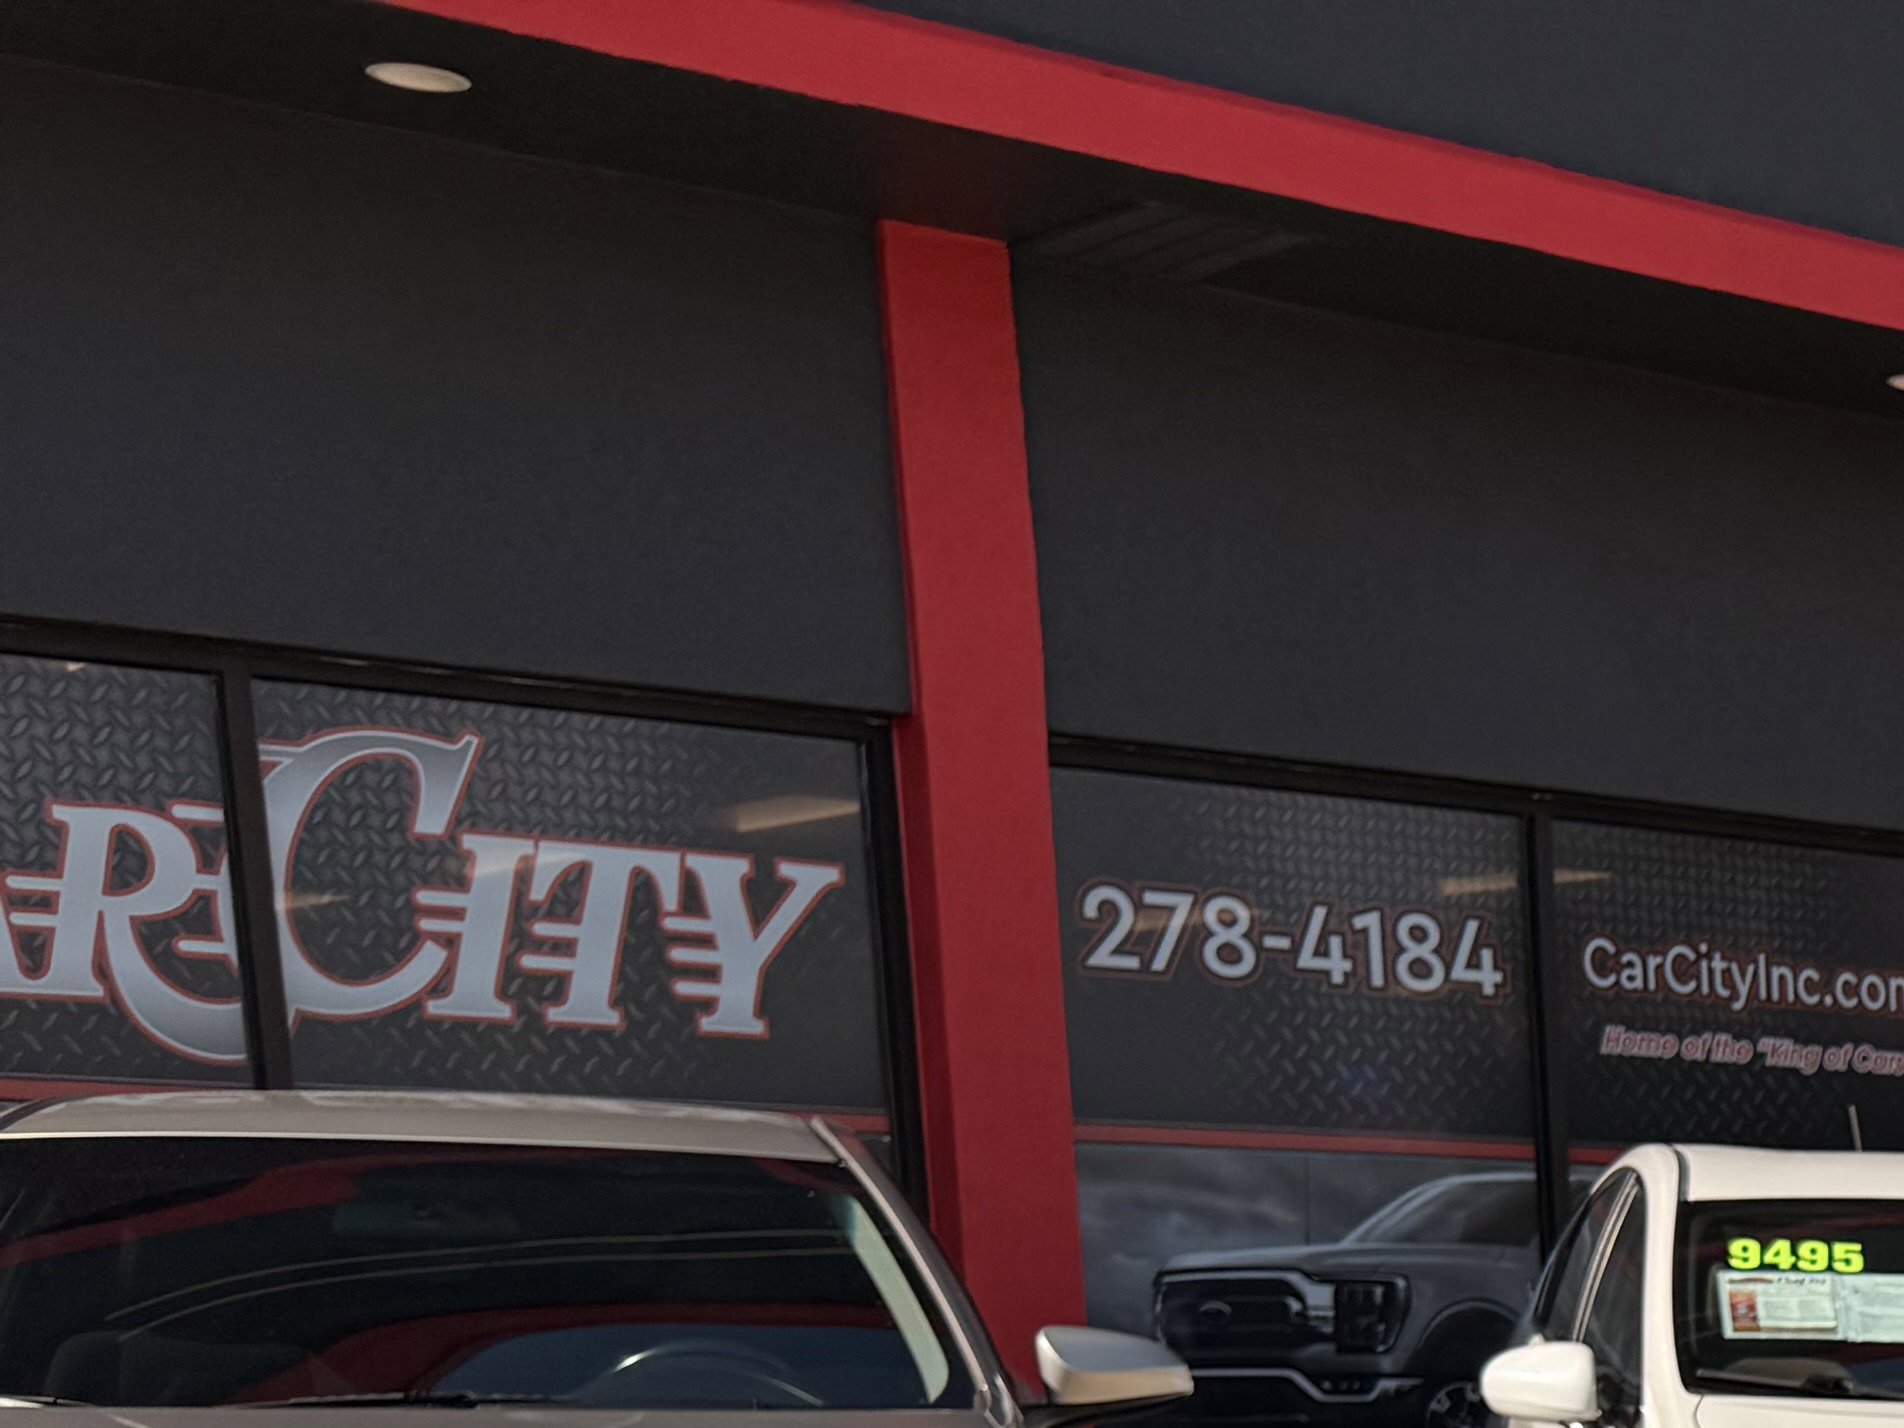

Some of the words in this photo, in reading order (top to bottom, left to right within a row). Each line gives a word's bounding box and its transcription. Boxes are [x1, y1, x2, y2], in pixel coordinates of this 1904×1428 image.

[1079, 883, 1504, 997] 278-4184
[1600, 1024, 1679, 1059] Home
[1680, 1031, 1712, 1061] of
[1709, 1032, 1754, 1065] the
[1822, 1041, 1854, 1072] of
[1728, 1238, 1864, 1274] 9495
